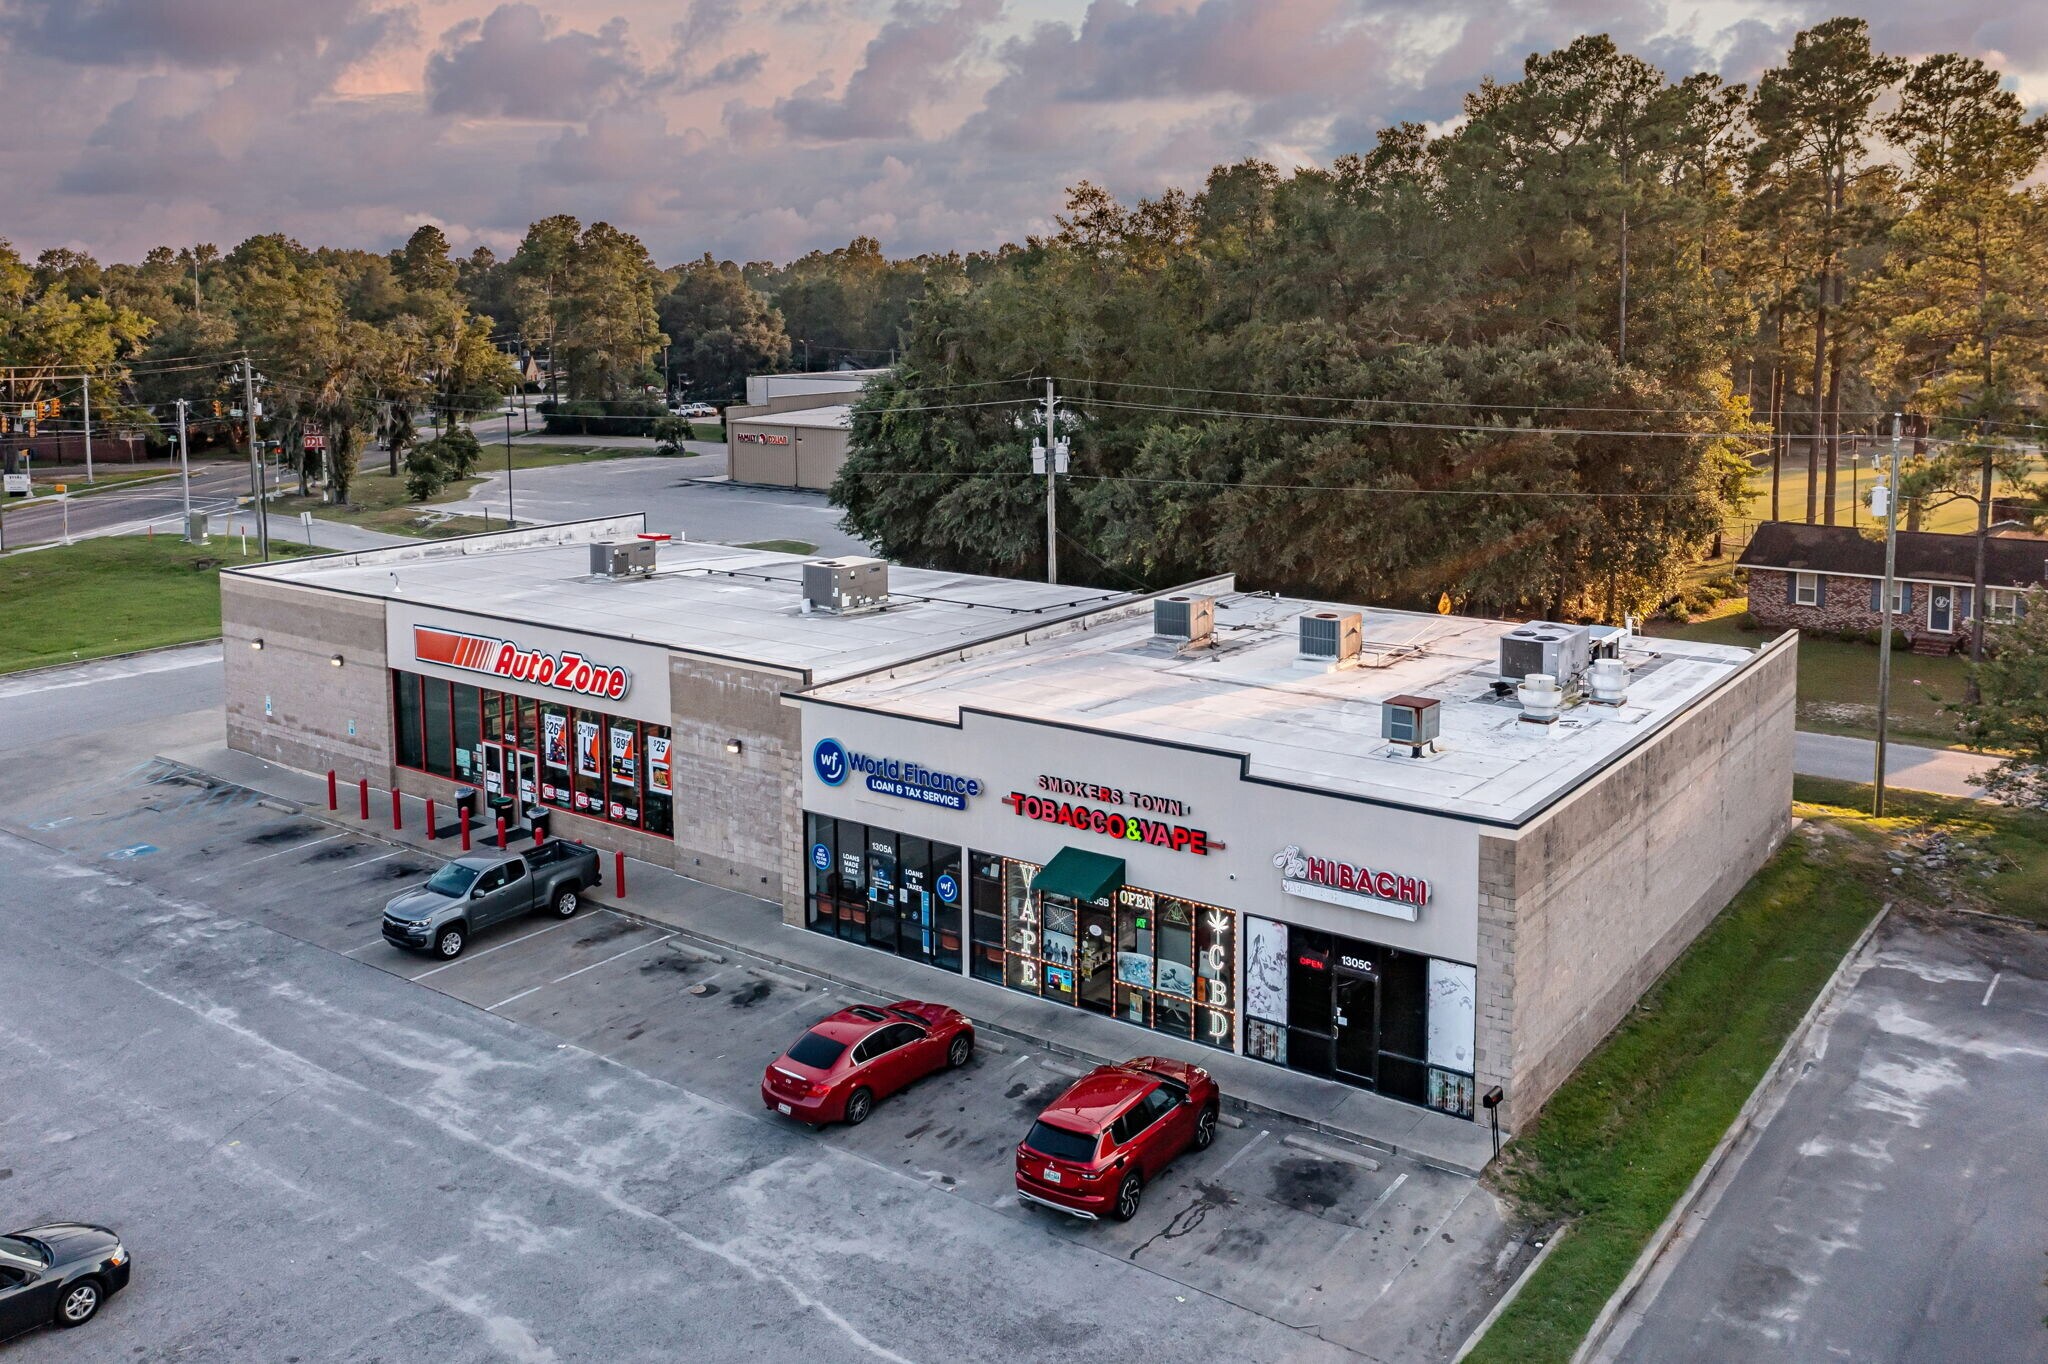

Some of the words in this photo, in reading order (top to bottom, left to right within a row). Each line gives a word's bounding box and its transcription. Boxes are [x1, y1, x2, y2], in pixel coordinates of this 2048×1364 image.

[494, 642, 627, 699] AutoZone
[653, 740, 666, 753] $25
[847, 751, 899, 780] World
[904, 763, 979, 797] Finance
[871, 779, 895, 793] LOAN
[896, 784, 903, 794] &
[904, 786, 922, 799] TAX
[922, 790, 960, 807] SERVICE
[1038, 775, 1124, 805] SMOKERS
[1129, 791, 1183, 817] TOWN
[1010, 791, 1209, 855] TOBACCO&VAPE
[842, 853, 860, 862] LOANS
[871, 842, 893, 855] 1305A
[843, 860, 859, 869] MADE
[845, 867, 858, 875] EASY
[905, 869, 924, 879] LOANS
[1307, 856, 1429, 907] HIBACHI
[905, 882, 923, 892] TAXES
[1119, 890, 1153, 910] OPEN
[1019, 864, 1037, 986] VAPE
[1299, 957, 1324, 969] OPEN
[1341, 955, 1372, 971] 1305C
[1208, 944, 1228, 1037] CBD
